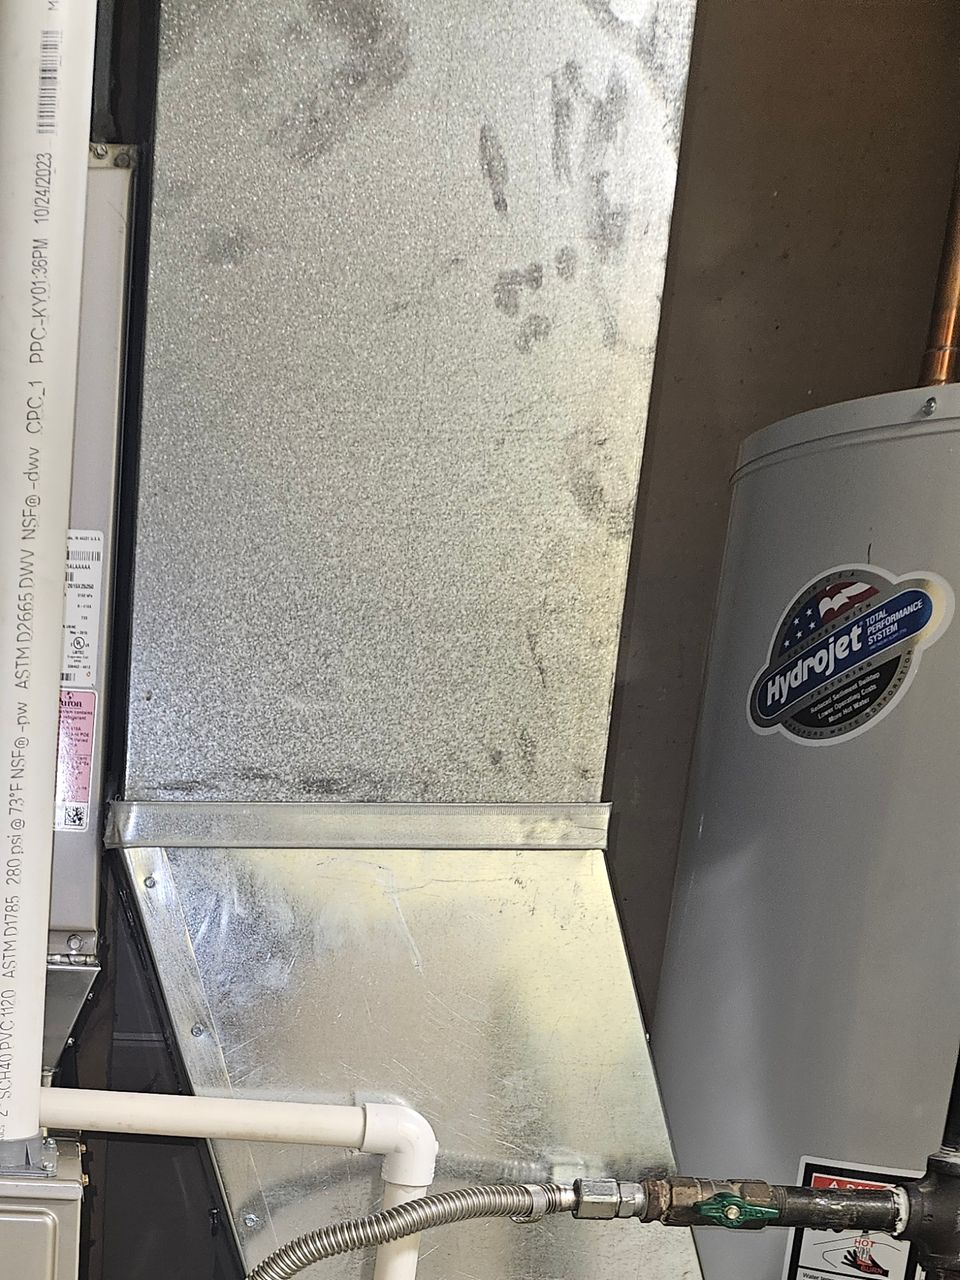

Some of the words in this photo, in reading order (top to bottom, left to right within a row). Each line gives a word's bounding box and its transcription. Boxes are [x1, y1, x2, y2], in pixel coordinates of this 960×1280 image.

[34, 153, 53, 224] 10/24/2023
[18, 550, 35, 587] DWV
[15, 592, 34, 642] D2665
[866, 609, 887, 625] TOTAL
[867, 599, 924, 635] PERFORMANCE
[867, 624, 898, 645] SYSTEM
[14, 647, 30, 689] ASTM
[766, 623, 862, 706] Hydrojet
[59, 699, 81, 707] uron
[10, 819, 24, 830] @
[7, 834, 24, 854] psi
[6, 858, 22, 884] 280
[4, 896, 20, 936] D1785
[2, 940, 18, 978] ASTM
[0, 990, 16, 1016] 1120
[853, 1238, 874, 1248] HOT
[802, 1272, 819, 1280] Water
